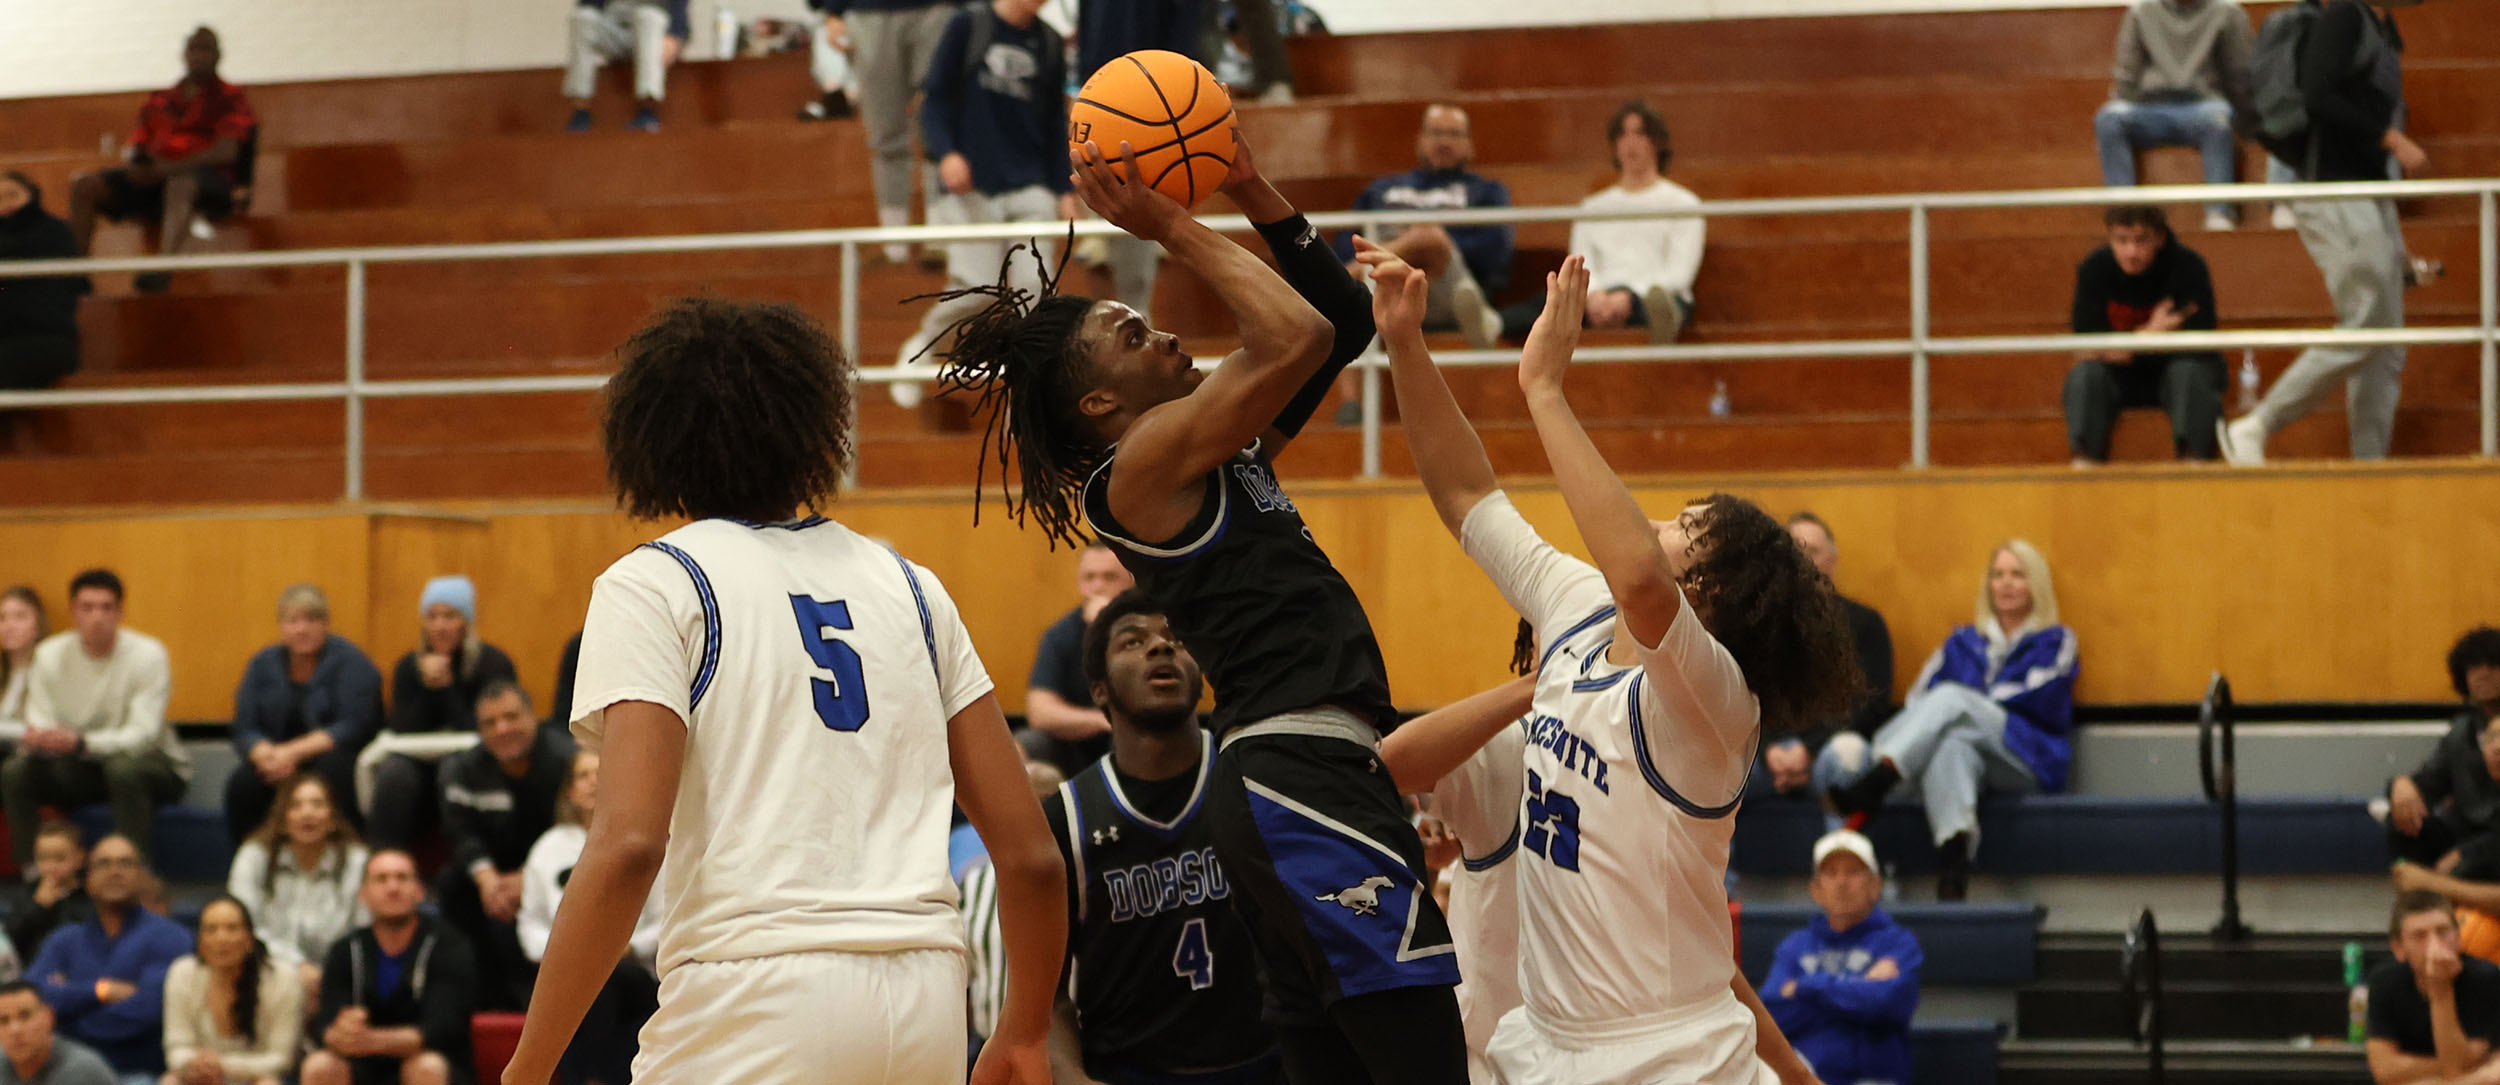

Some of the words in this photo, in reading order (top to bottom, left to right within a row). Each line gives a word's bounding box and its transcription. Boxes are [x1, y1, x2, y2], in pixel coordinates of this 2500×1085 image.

[787, 589, 870, 733] 5
[1526, 714, 1609, 796] MESITE
[1523, 768, 1581, 873] 23
[1173, 918, 1213, 991] 4
